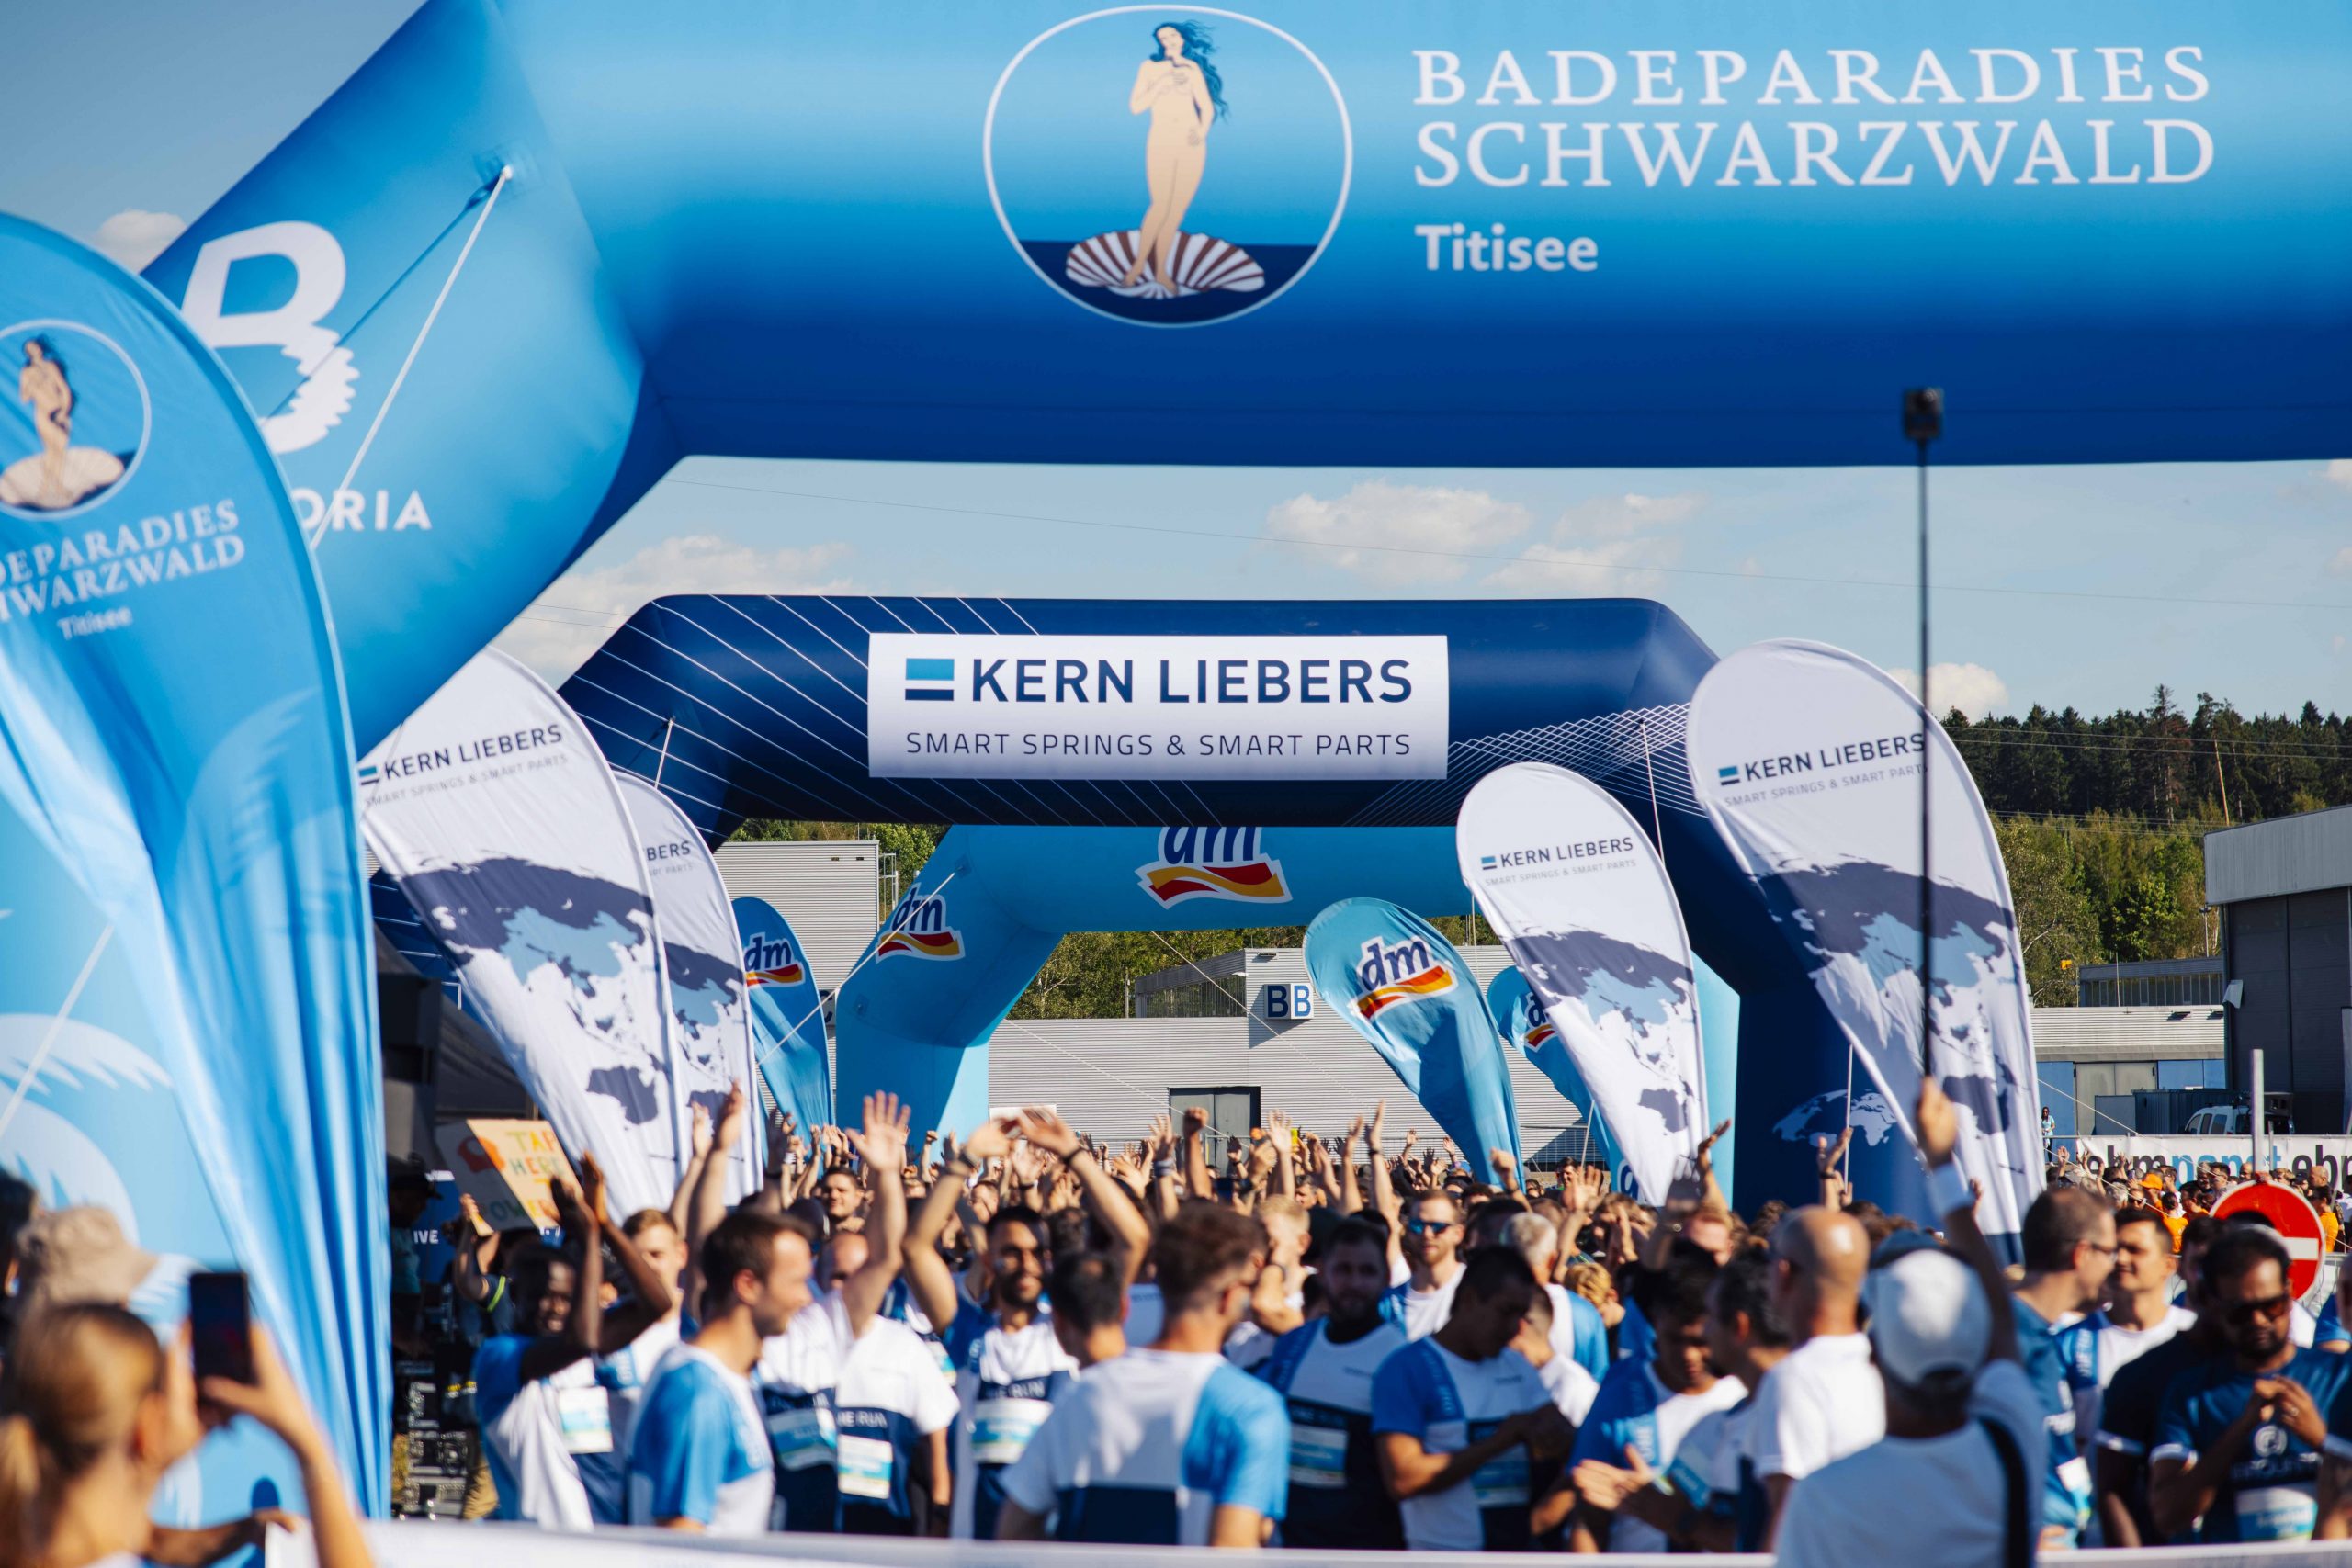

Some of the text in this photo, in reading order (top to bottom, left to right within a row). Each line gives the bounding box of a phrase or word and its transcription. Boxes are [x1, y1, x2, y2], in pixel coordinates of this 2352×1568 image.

[1412, 46, 2211, 107] BADEPARADIES
[1412, 119, 2215, 187] SCHWARZWALD
[1414, 222, 1599, 273] Titisee
[0, 498, 240, 590] EPARADIES
[972, 658, 1412, 704] KERN LIEBERS
[383, 724, 563, 781] KERN LIEBERS
[905, 732, 1411, 757] SMART SPRINGS & SMART PARTS
[1745, 732, 1926, 782] KERN LIEBERS
[1889, 763, 1928, 779] PART
[1499, 837, 1634, 868] KERN LIEBERS
[891, 887, 943, 931] dm
[744, 936, 793, 972] dm
[1362, 941, 1430, 992] dm
[1268, 986, 1289, 1018] B
[1294, 986, 1311, 1017] B
